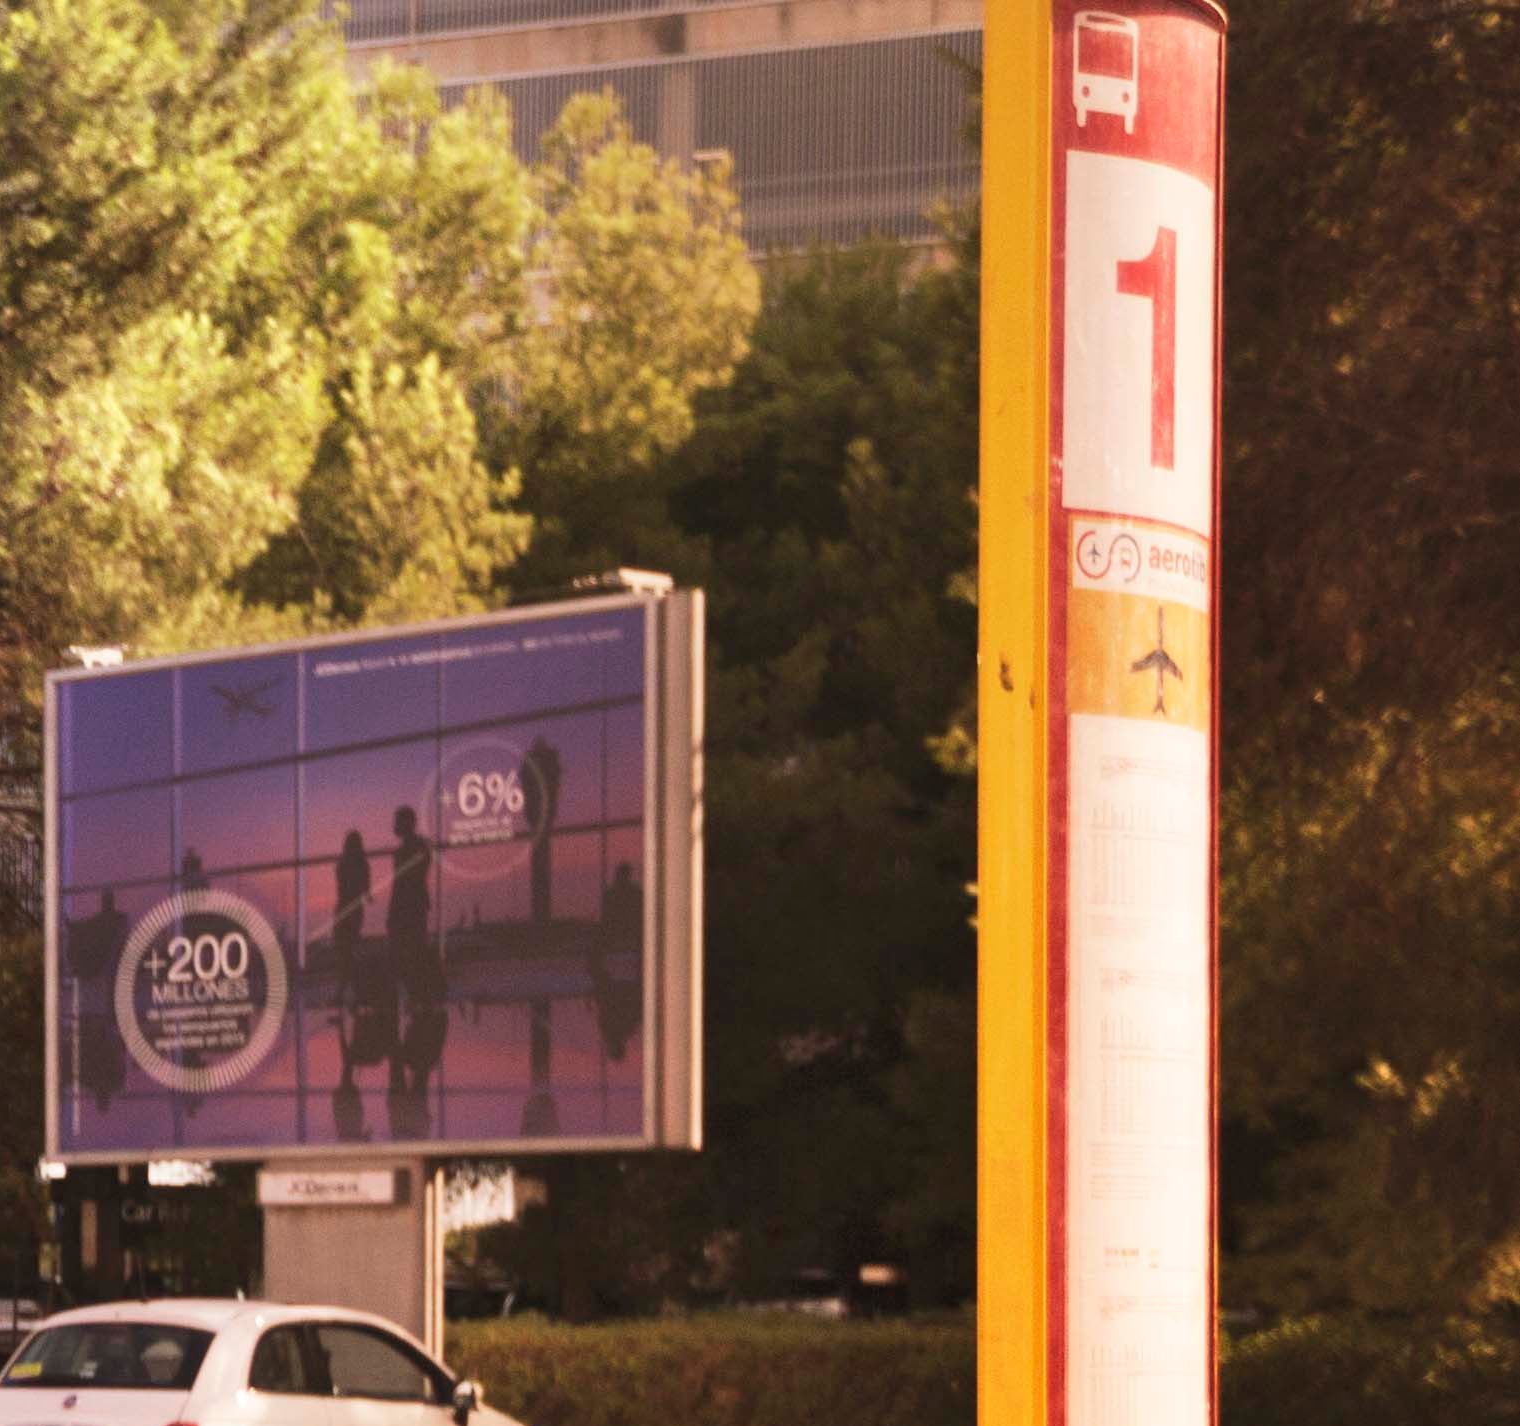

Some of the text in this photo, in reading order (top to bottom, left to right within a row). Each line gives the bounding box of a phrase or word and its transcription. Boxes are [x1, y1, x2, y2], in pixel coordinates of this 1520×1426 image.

[1116, 225, 1177, 471] 1
[441, 768, 525, 817] +6%
[143, 932, 249, 982] +200
[151, 977, 250, 1003] MILLONES
